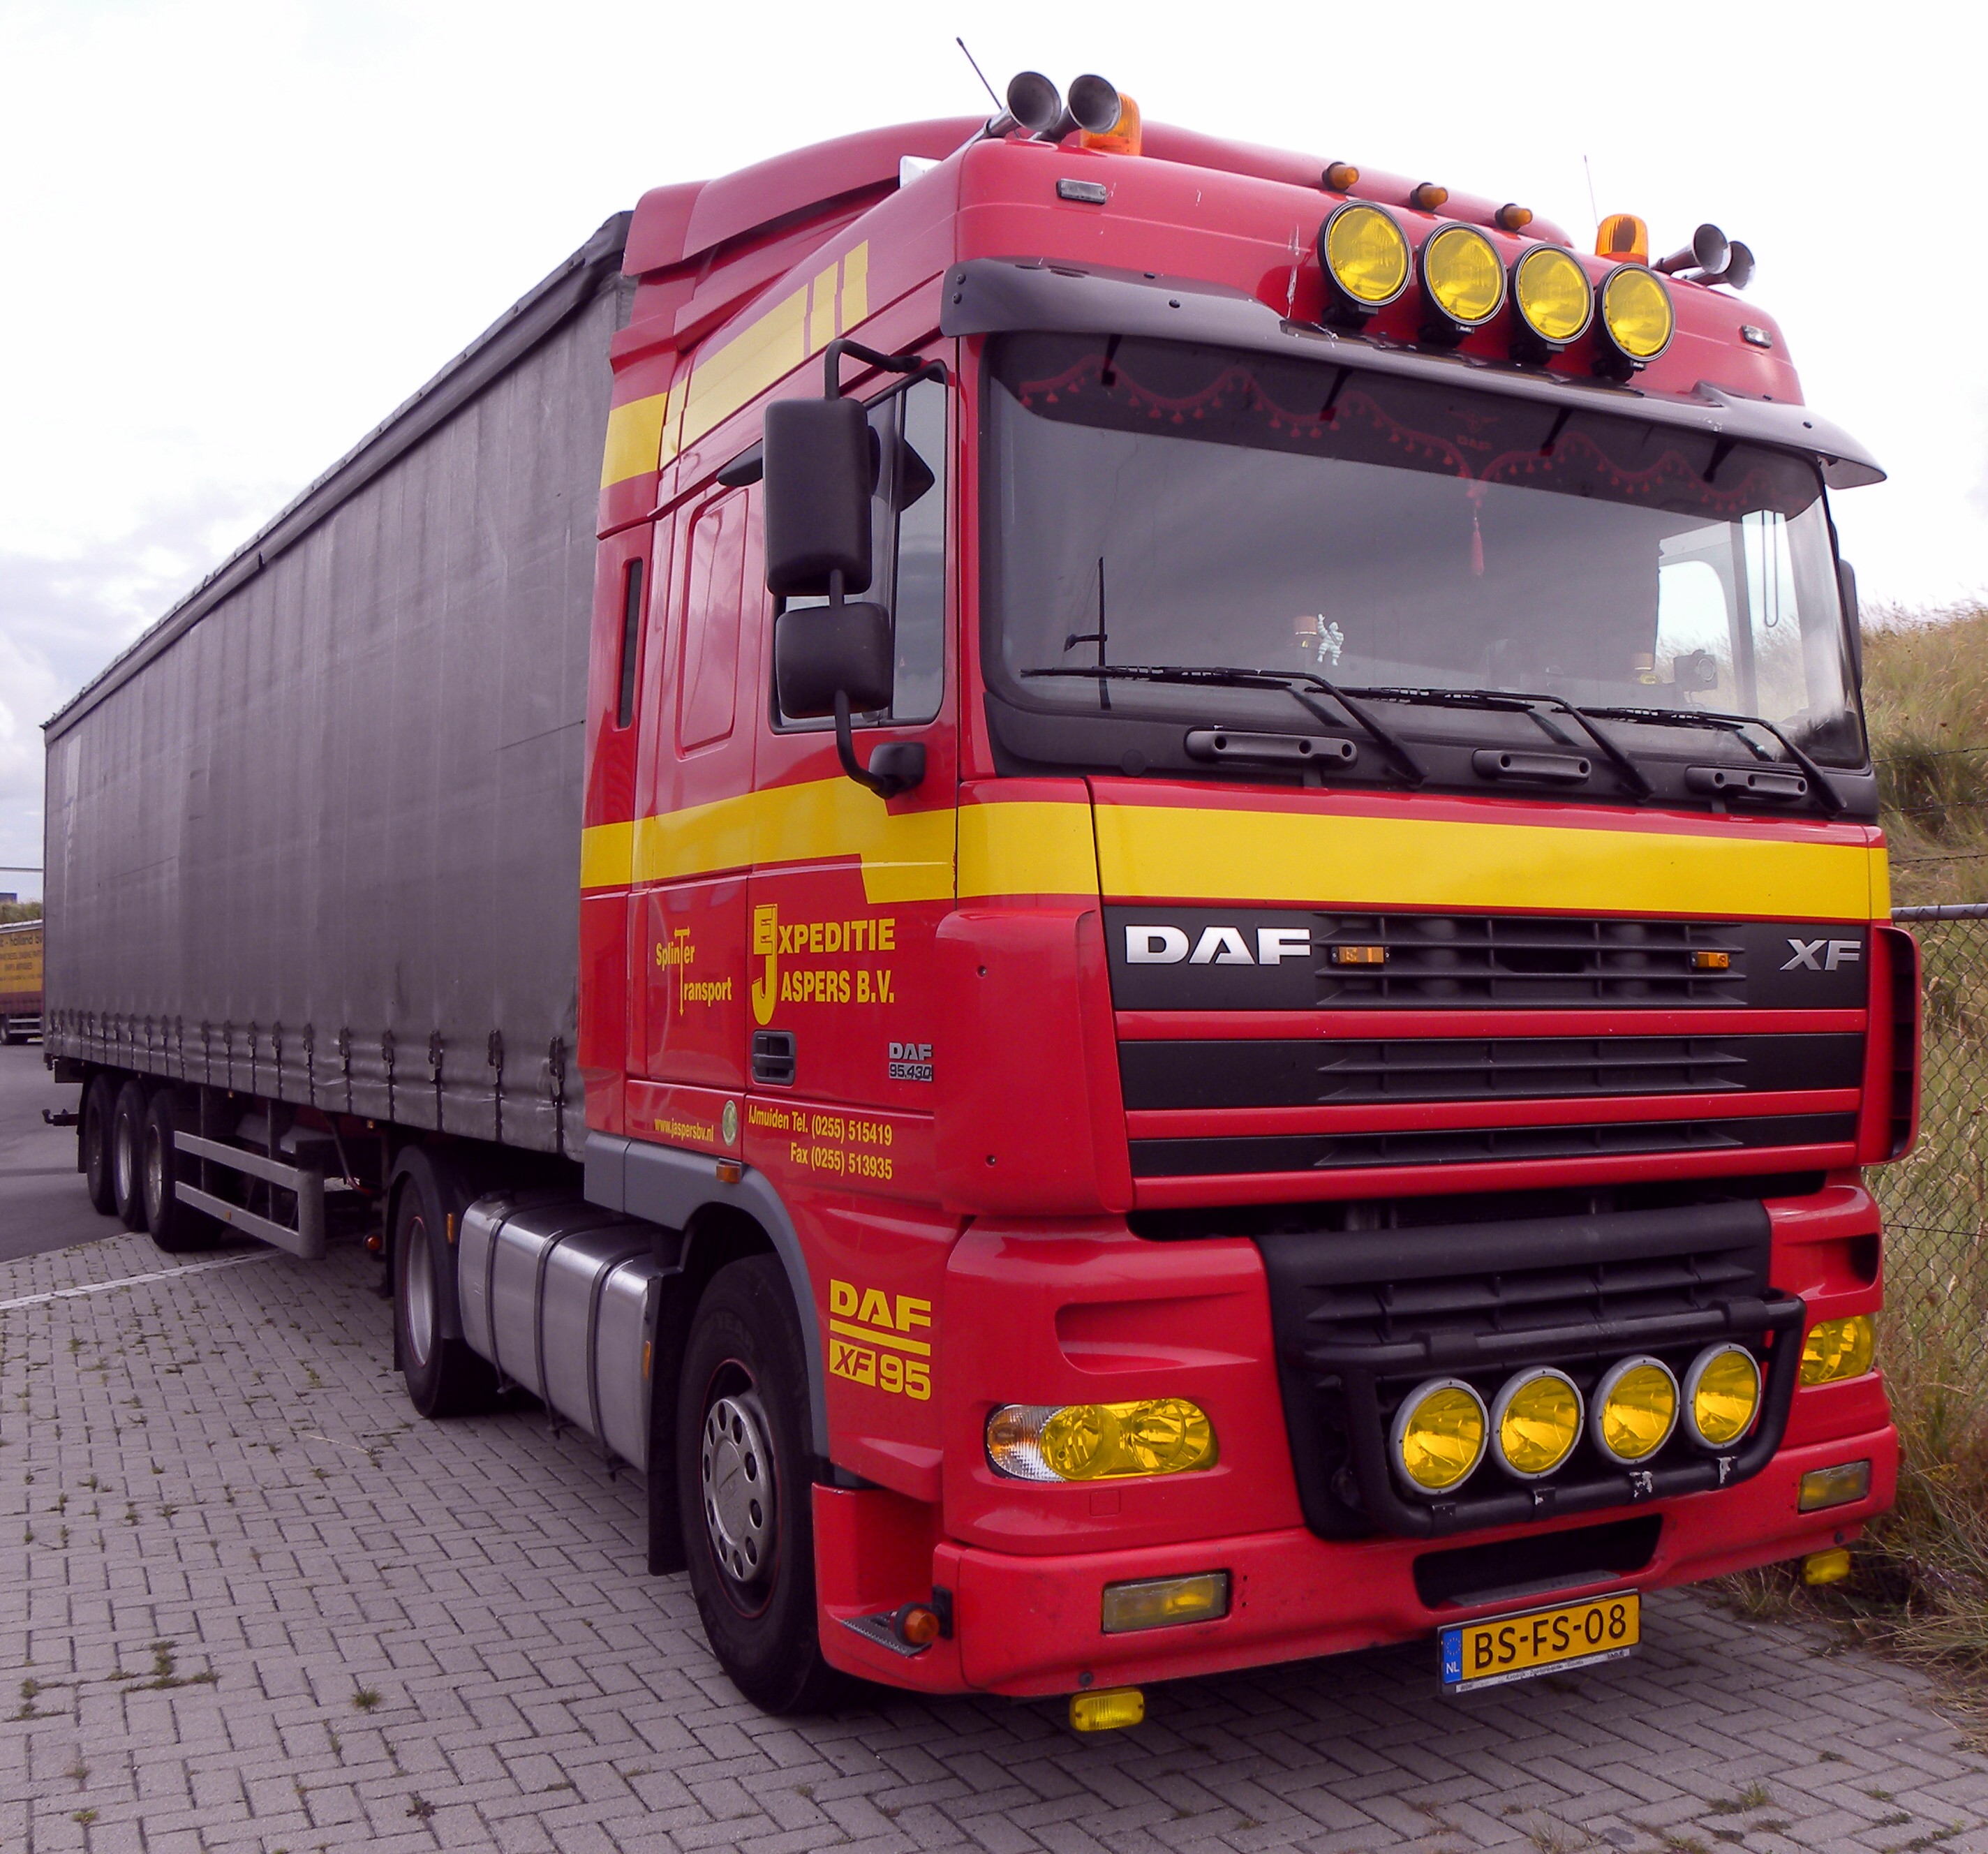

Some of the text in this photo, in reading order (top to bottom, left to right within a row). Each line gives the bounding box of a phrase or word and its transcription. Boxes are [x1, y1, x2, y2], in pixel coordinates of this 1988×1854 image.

[753, 905, 896, 955] EXPEDITIE
[1125, 925, 1311, 965] DAF
[1780, 939, 1862, 970] XF
[857, 970, 894, 1003] B.V.
[889, 1042, 932, 1060] DAF
[890, 1064, 932, 1079] 95.430
[655, 1118, 714, 1141] www.jaspersbv.nl
[792, 1111, 808, 1133] Tel.
[811, 1114, 845, 1143] (0255)
[849, 1120, 893, 1146] 515419
[790, 1142, 893, 1180] Fax (0255) 513935
[830, 1279, 931, 1332] DAF
[833, 1343, 931, 1401] XF 95
[1474, 1604, 1626, 1669] BS-FS-08
[1446, 1661, 1460, 1673] NL
